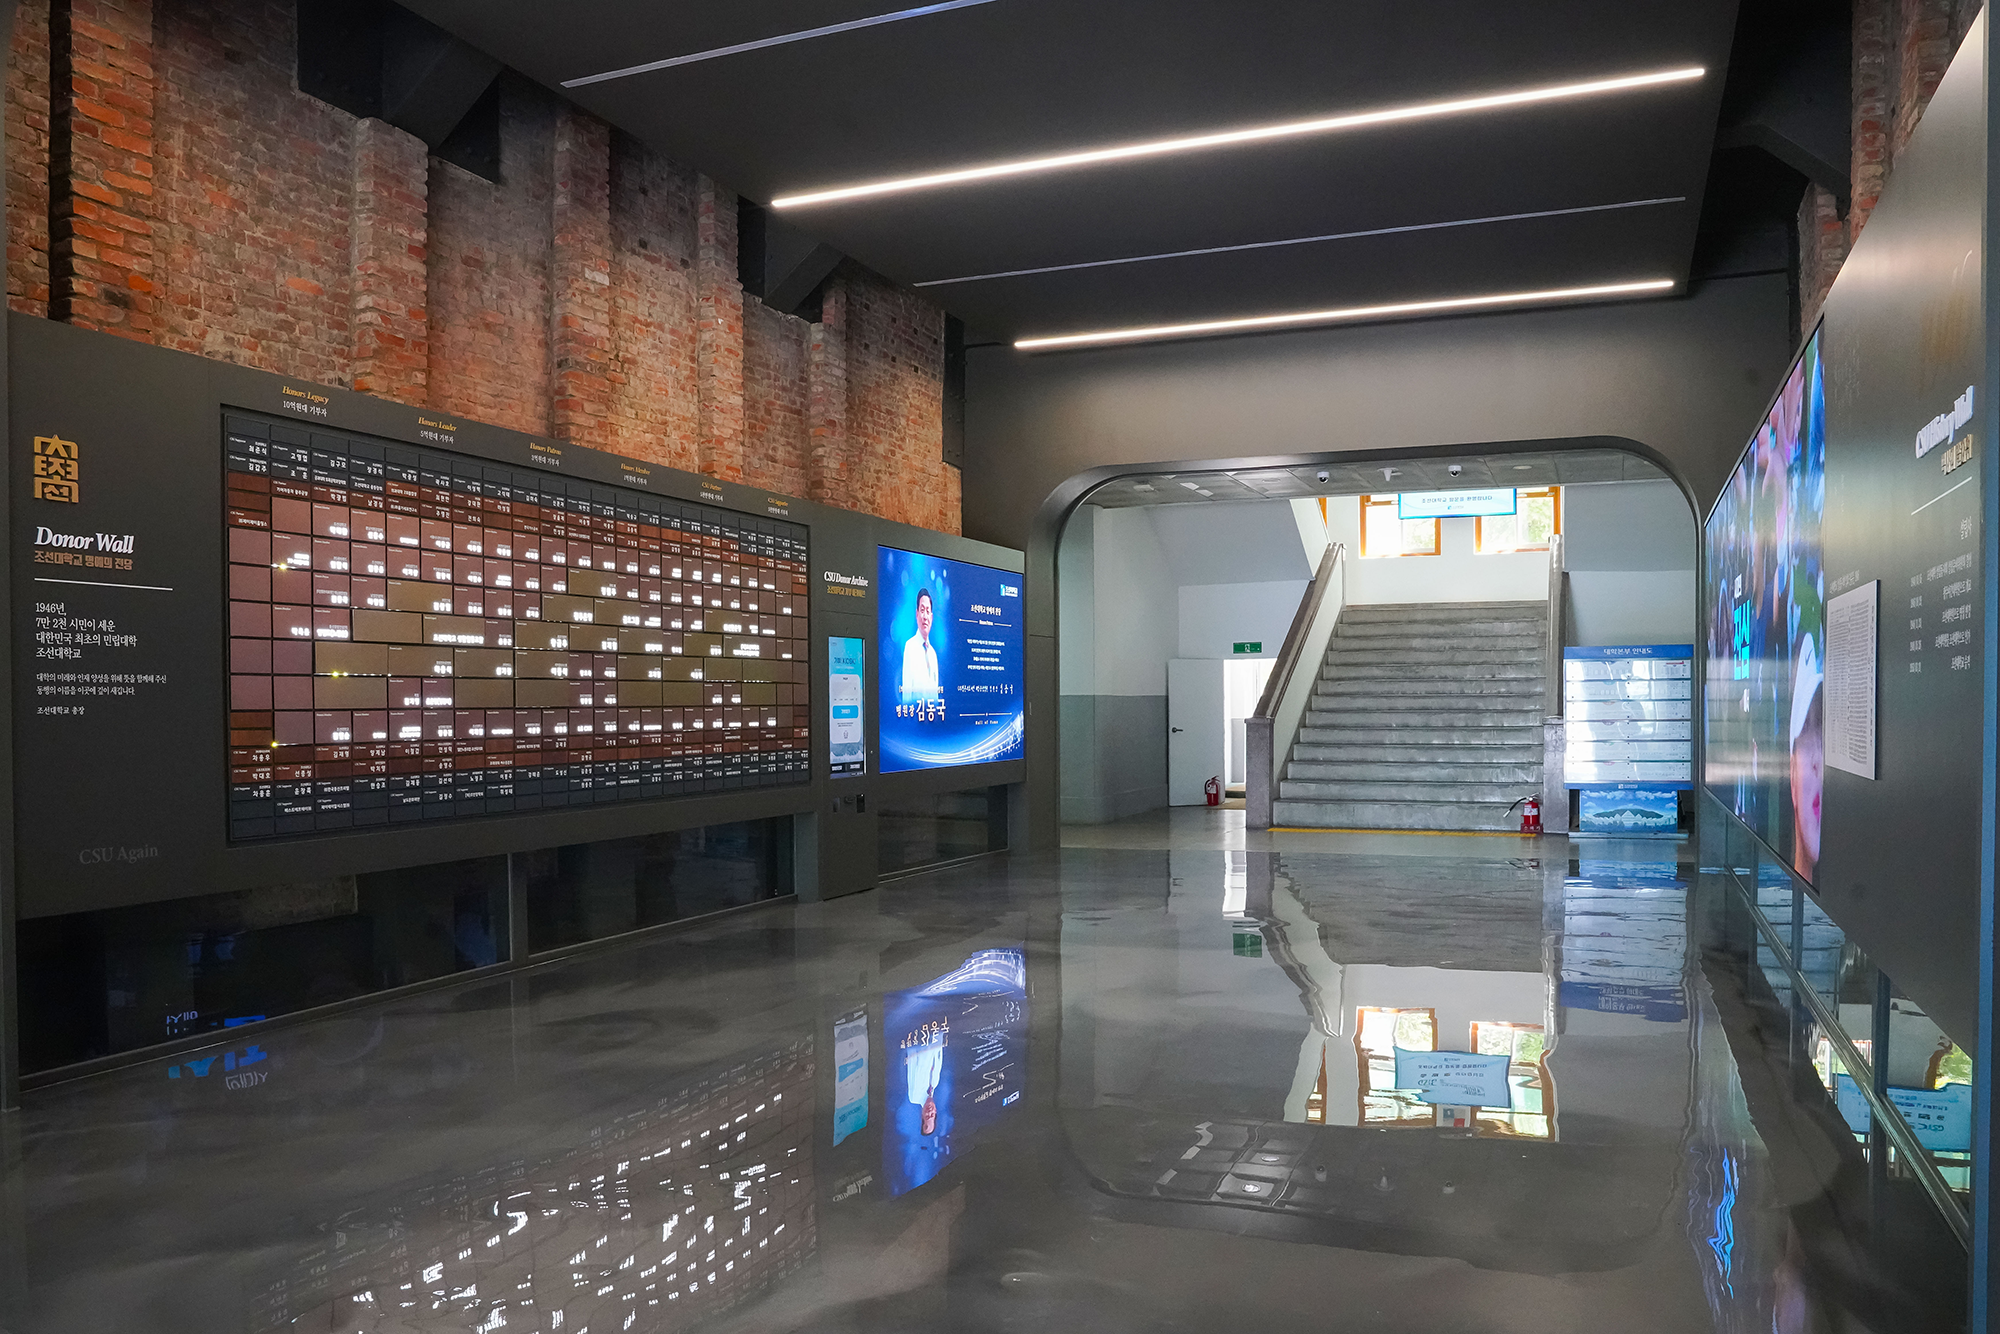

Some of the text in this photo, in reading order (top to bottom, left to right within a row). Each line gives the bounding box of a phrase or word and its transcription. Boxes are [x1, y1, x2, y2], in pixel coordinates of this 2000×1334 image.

[282, 386, 330, 405] Honors Legacy
[418, 417, 438, 428] Honors
[34, 526, 135, 554] Donor Wall
[34, 550, 134, 571] 조선대학교 명예의 전당
[35, 602, 67, 616] 1946년,
[35, 616, 116, 633] 7만 2천 시민이 세운
[35, 631, 138, 647] 대한민국 최초의 민립대학
[35, 647, 82, 660] 조선대학교
[36, 706, 70, 716] 조선대학교
[915, 697, 947, 722] 김동국
[79, 844, 158, 864] CSU Again
